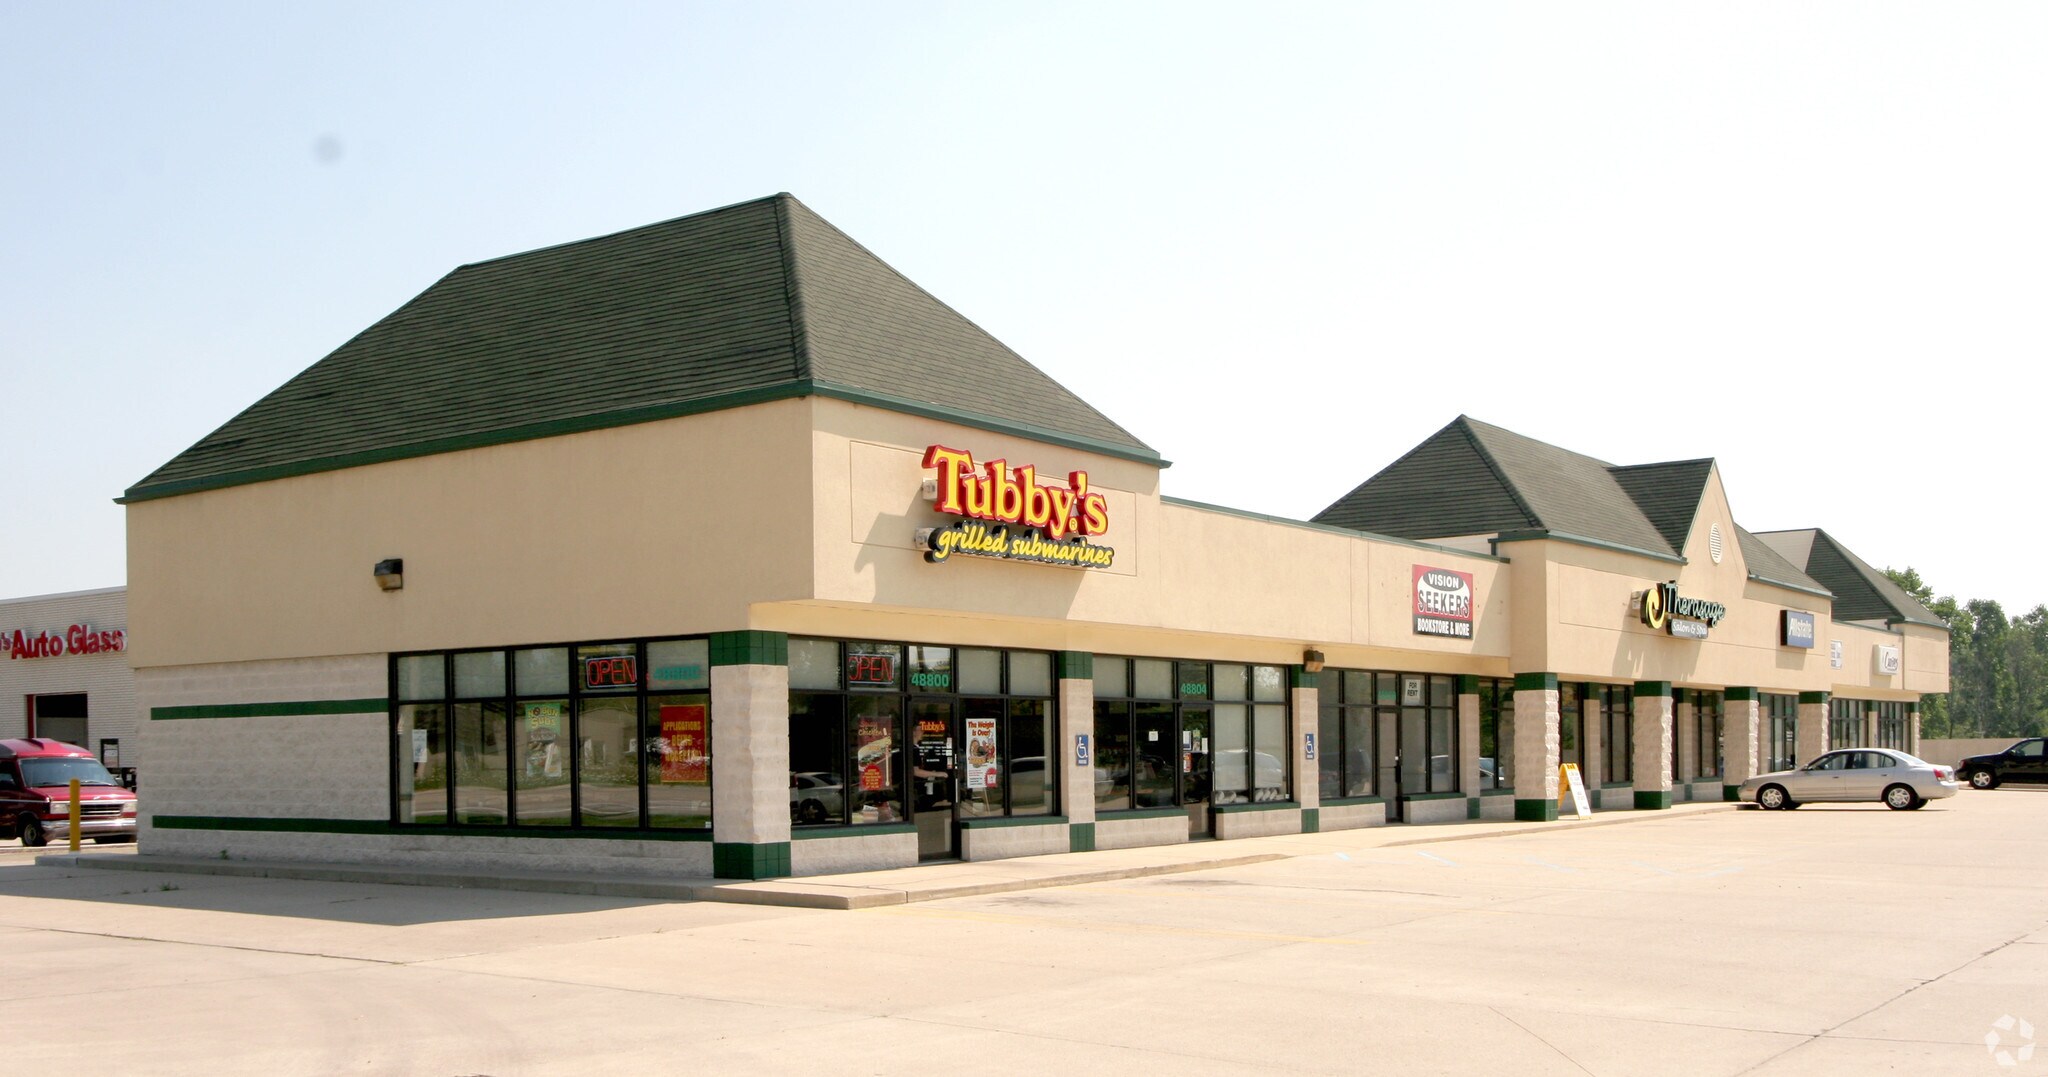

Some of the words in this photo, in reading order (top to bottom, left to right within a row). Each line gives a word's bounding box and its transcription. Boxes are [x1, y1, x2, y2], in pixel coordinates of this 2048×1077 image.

[922, 445, 1108, 540] Tubby's
[934, 526, 1009, 561] grilled
[1011, 533, 1114, 567] submarines
[1428, 573, 1459, 589] VISION
[1418, 589, 1469, 618] SEEKERS
[1417, 618, 1450, 634] BOOKSTORE
[1450, 621, 1454, 635] &
[1455, 622, 1470, 636] MORE
[1672, 621, 1690, 633] Salon
[11, 630, 63, 660] Auto
[67, 624, 124, 655] Glass
[589, 659, 636, 685] OPEN
[848, 656, 893, 681] OPEN
[911, 673, 949, 687] 48800
[1181, 683, 1206, 694] 48804
[919, 721, 945, 732] Tubby's
